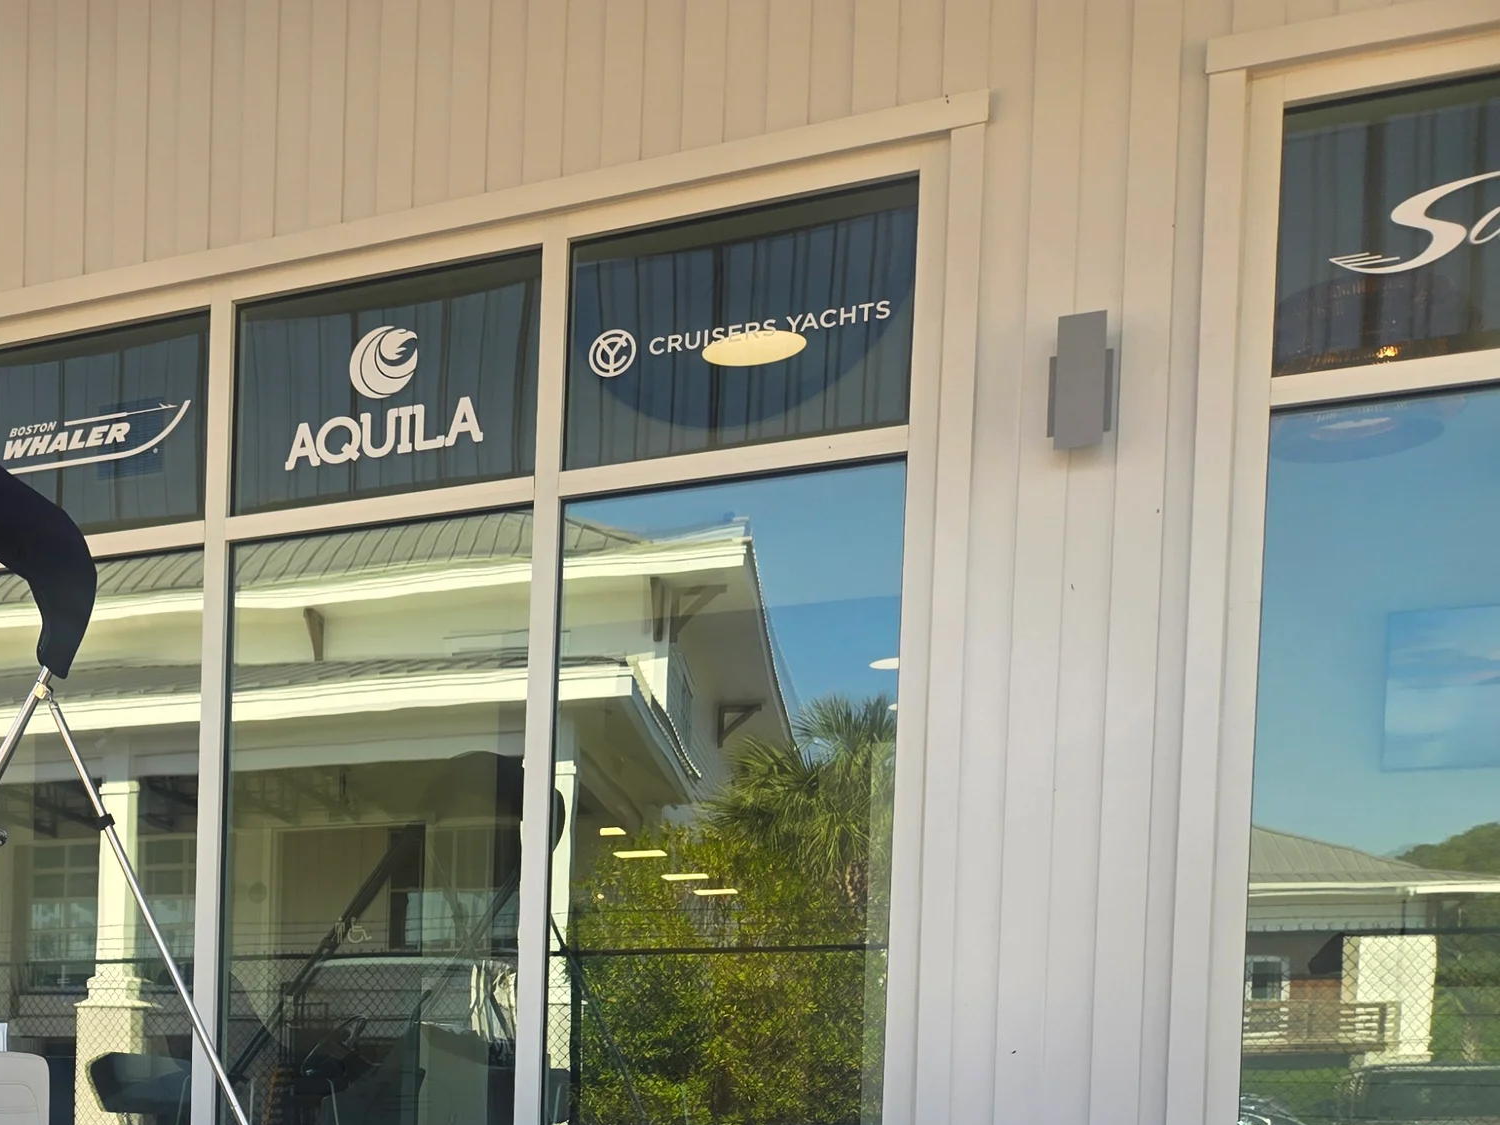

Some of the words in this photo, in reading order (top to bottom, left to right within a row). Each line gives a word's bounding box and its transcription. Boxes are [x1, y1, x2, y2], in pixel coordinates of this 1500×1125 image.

[649, 318, 777, 355] CRUISERS
[786, 300, 892, 334] YACHTS
[3, 422, 131, 461] WHALER
[9, 421, 58, 438] BOSTON
[284, 396, 484, 471] AQUILA
